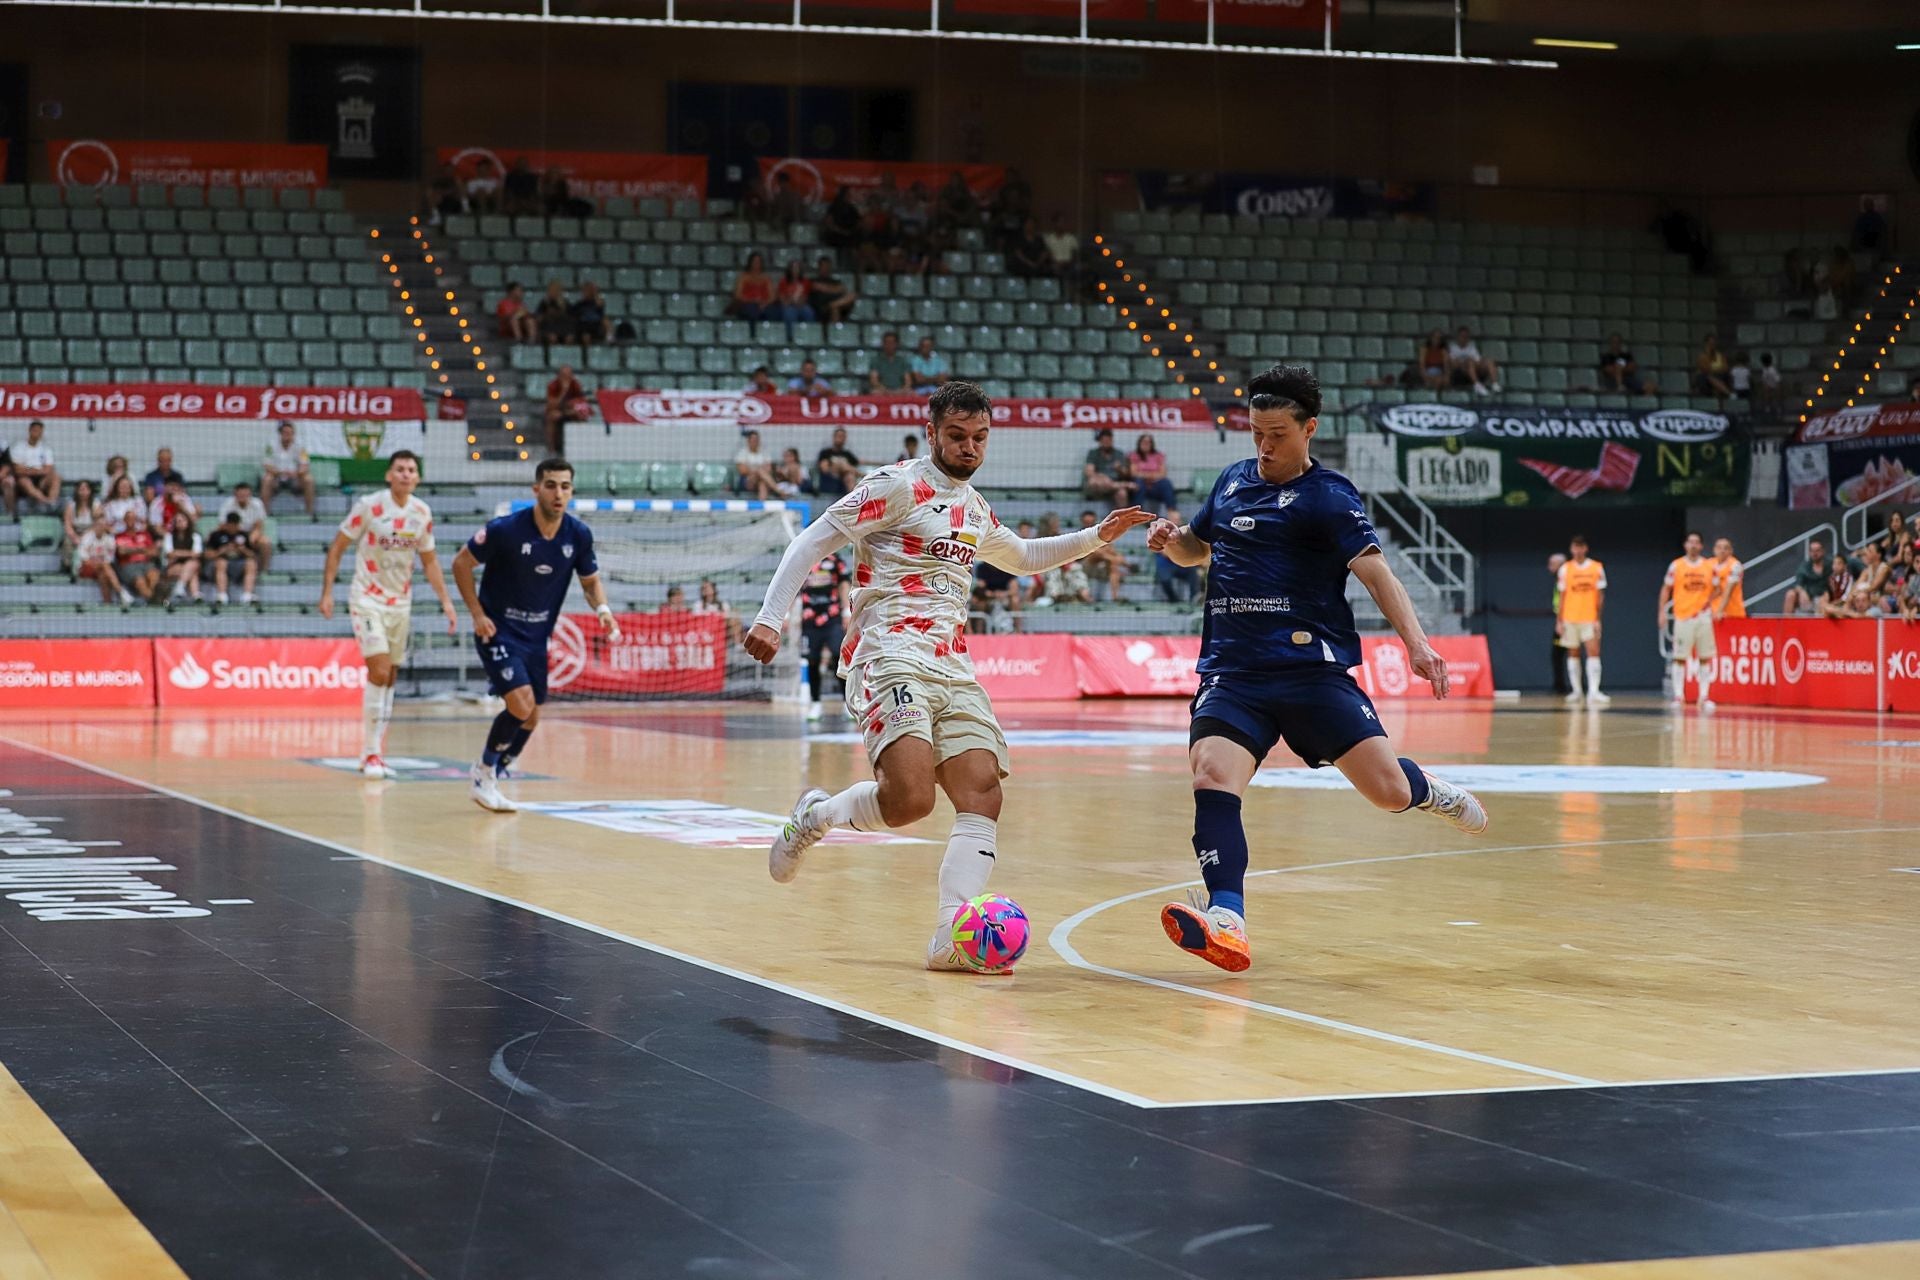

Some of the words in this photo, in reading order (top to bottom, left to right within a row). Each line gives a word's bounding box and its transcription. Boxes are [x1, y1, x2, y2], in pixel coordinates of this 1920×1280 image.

[70, 390, 146, 411] más
[158, 391, 204, 412] de
[214, 391, 247, 412] la
[256, 388, 392, 418] familia
[800, 396, 878, 418] Uno
[990, 405, 1011, 422] e
[1021, 404, 1051, 422] la
[1062, 402, 1184, 427] familia
[1485, 417, 1640, 438] COMPARTIR
[1418, 457, 1489, 485] LEGADO
[1230, 597, 1281, 605] PATRIMONIO
[1230, 604, 1290, 613] HUMANIDAD
[1730, 636, 1774, 656] 1200
[50, 671, 73, 687] DE
[76, 671, 144, 687] MURCIA
[212, 659, 368, 688] Santander
[892, 684, 913, 707] 16
